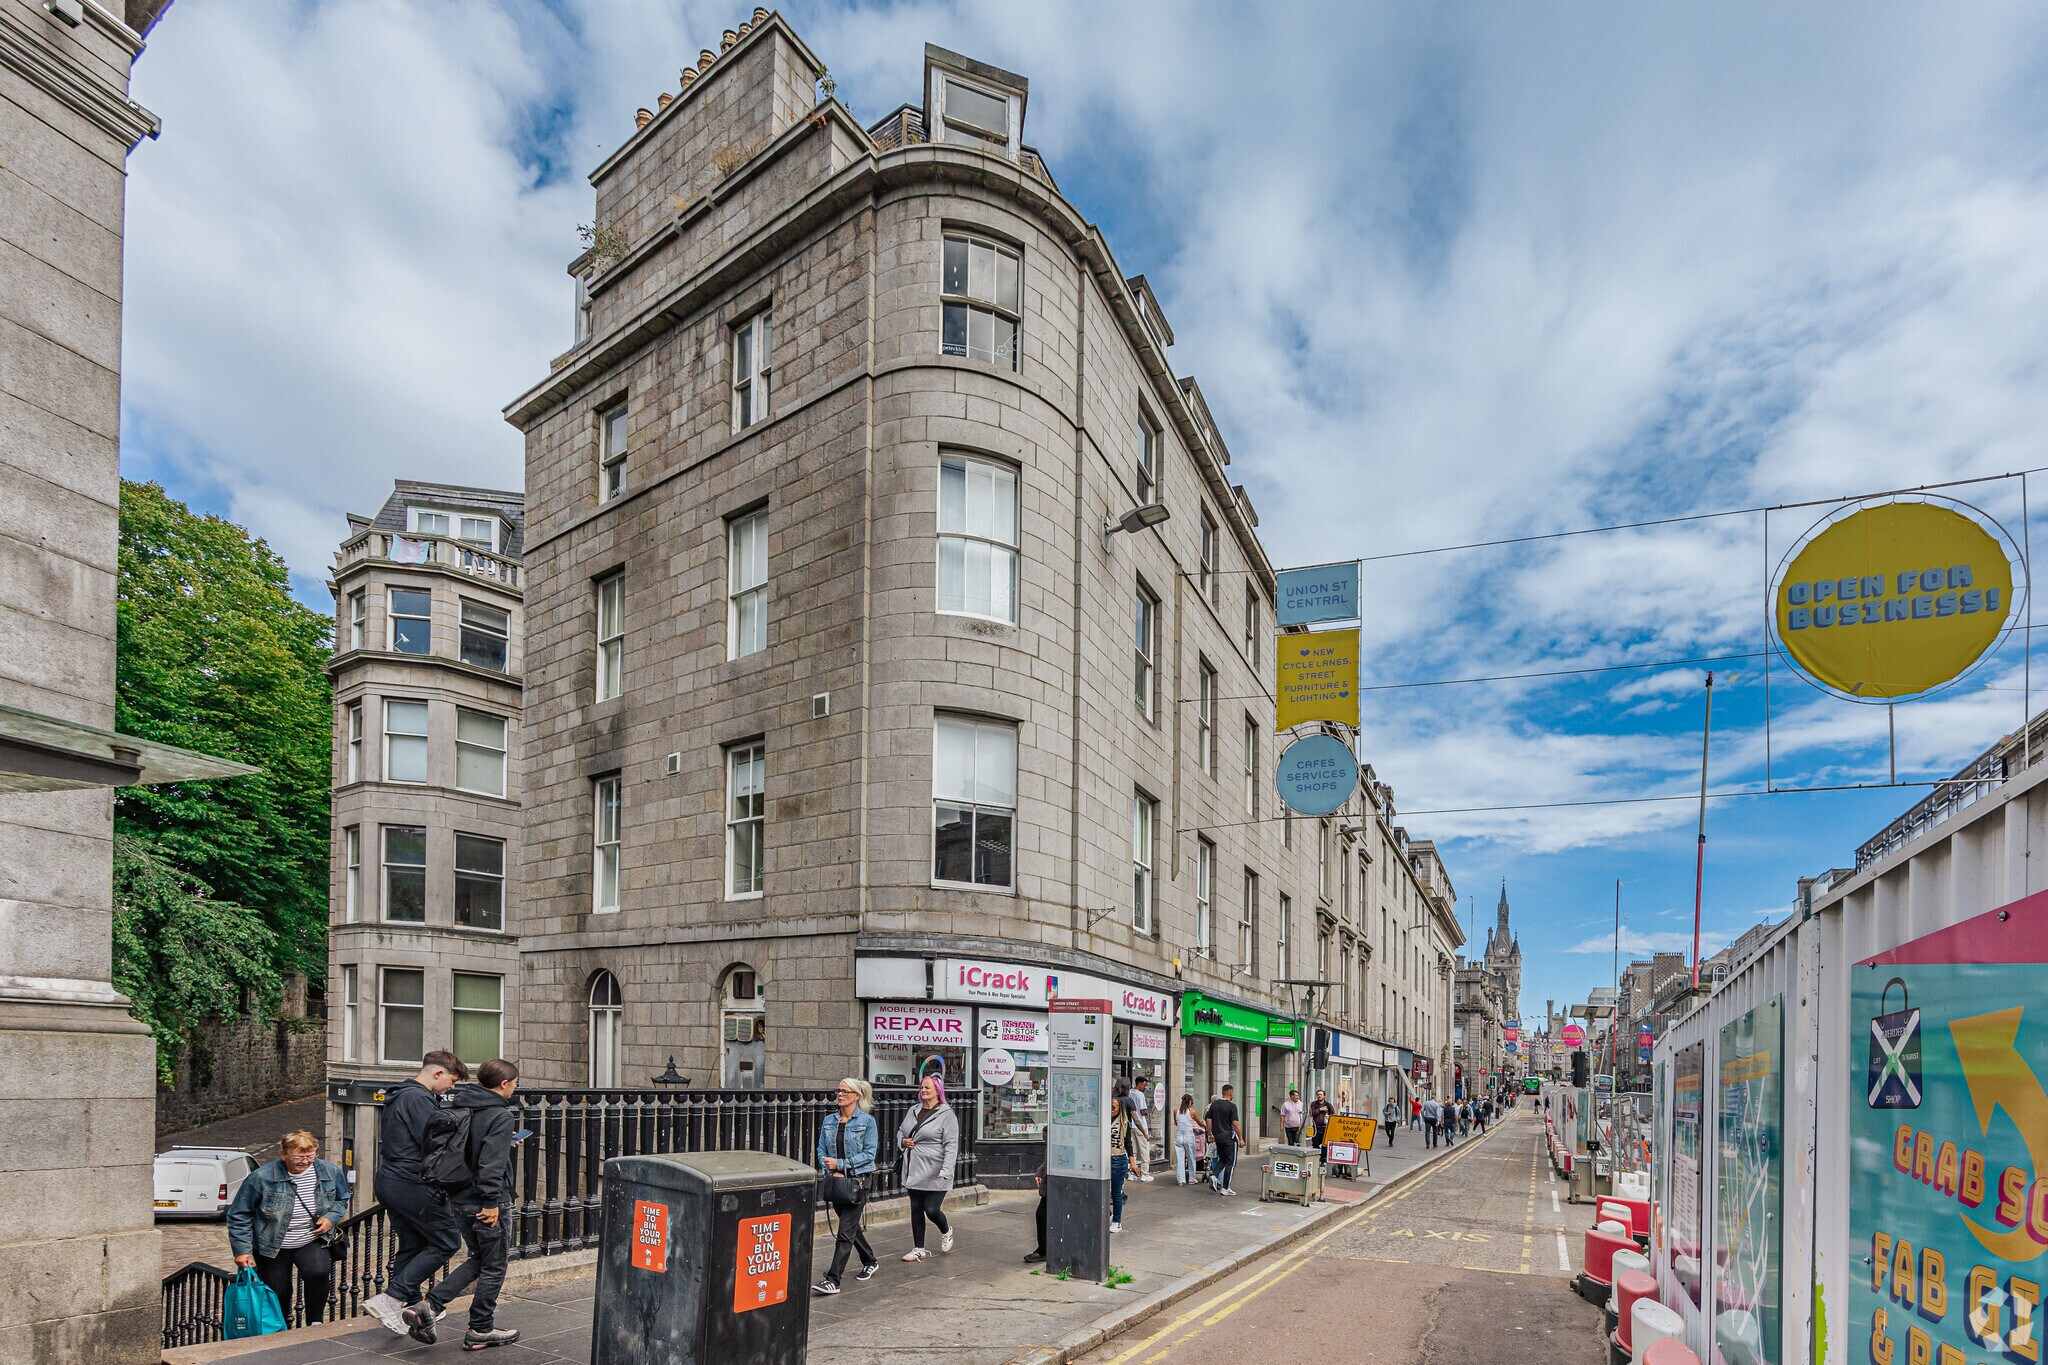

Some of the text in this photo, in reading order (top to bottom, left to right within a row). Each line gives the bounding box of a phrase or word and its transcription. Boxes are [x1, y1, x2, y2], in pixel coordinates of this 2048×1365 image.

[1286, 581, 1348, 597] UNION ST
[1788, 565, 1974, 606] OPEN FOR
[1286, 594, 1348, 609] CENTRAL
[1788, 588, 2000, 630] BUSINESS!
[1313, 648, 1334, 656] NEW
[1283, 661, 1314, 670] CYCLE
[1298, 671, 1336, 680] STREET
[1284, 682, 1339, 693] FURNITURE
[1290, 693, 1336, 703] LIGHTING
[1296, 758, 1336, 770] CAFES
[1286, 770, 1346, 782] SERVICES
[1296, 782, 1337, 792] SHOPS
[960, 966, 1030, 990] iCrack
[1122, 990, 1156, 1013] iCrack
[874, 1016, 963, 1033] REPAIR
[1002, 1020, 1035, 1029] INSTANT
[1002, 1034, 1035, 1042] REPAIRS
[1881, 1026, 1908, 1039] ABERDEEN
[1886, 1095, 1901, 1104] SHOP
[1894, 1124, 1985, 1209] GRAB
[643, 1206, 660, 1216] TIME
[646, 1214, 656, 1222] TO
[644, 1222, 656, 1230] BIN
[750, 1222, 780, 1235] TIME
[640, 1228, 660, 1238] YOUR
[756, 1233, 772, 1243] TO
[1388, 1228, 1495, 1242] AXIS
[640, 1236, 661, 1246] GUM?
[754, 1242, 774, 1254] BIN
[747, 1251, 780, 1266] YOUR
[748, 1260, 781, 1276] GUM?
[1871, 1230, 1948, 1324] FAB
[1964, 1264, 2048, 1365] GI
[1869, 1307, 1894, 1365] &
